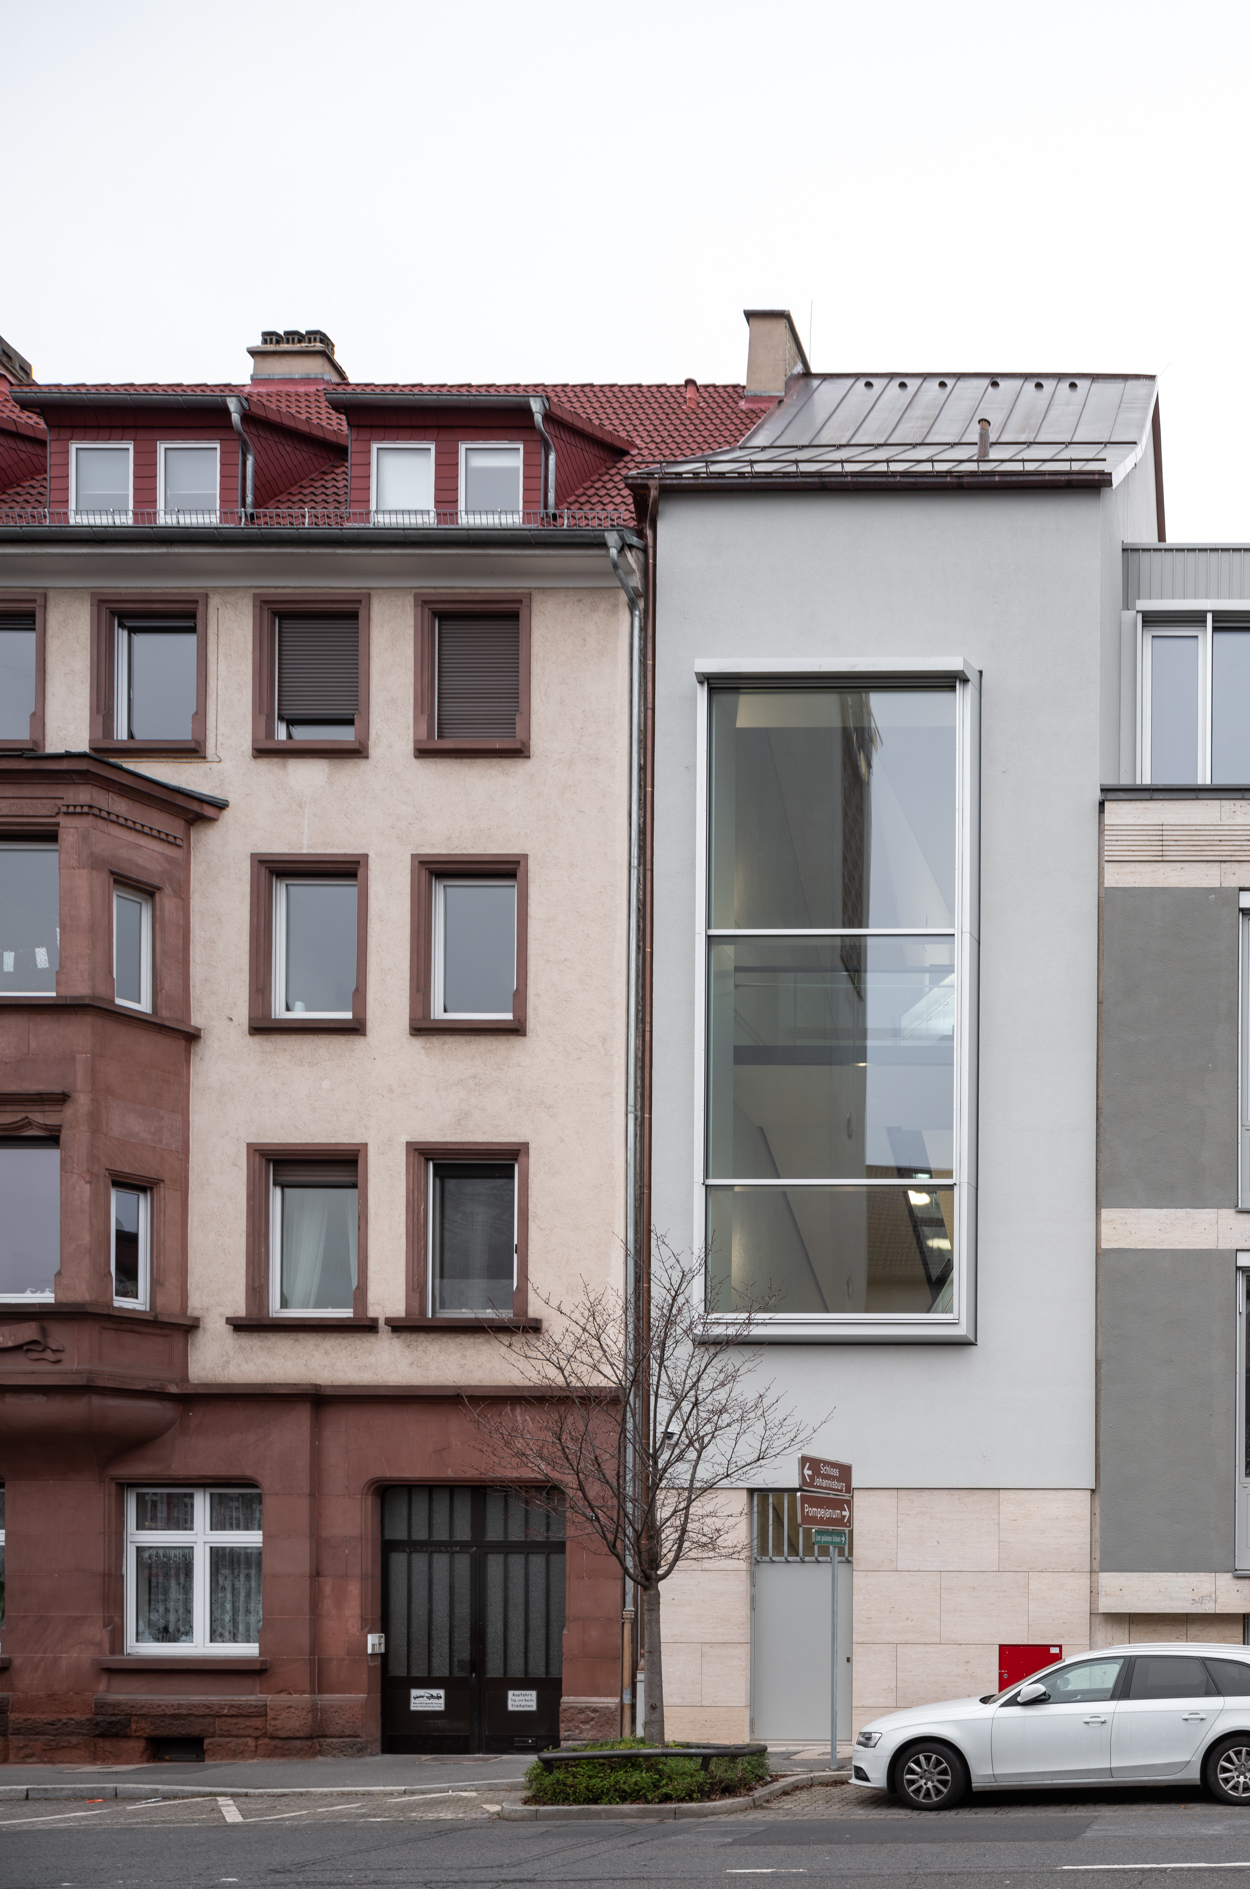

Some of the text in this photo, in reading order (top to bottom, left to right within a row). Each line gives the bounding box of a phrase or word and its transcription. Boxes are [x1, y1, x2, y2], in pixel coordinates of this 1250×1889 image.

[820, 1463, 839, 1477] Schloss
[813, 1475, 846, 1493] Johannisburg
[804, 1503, 842, 1520] Pompejanum
